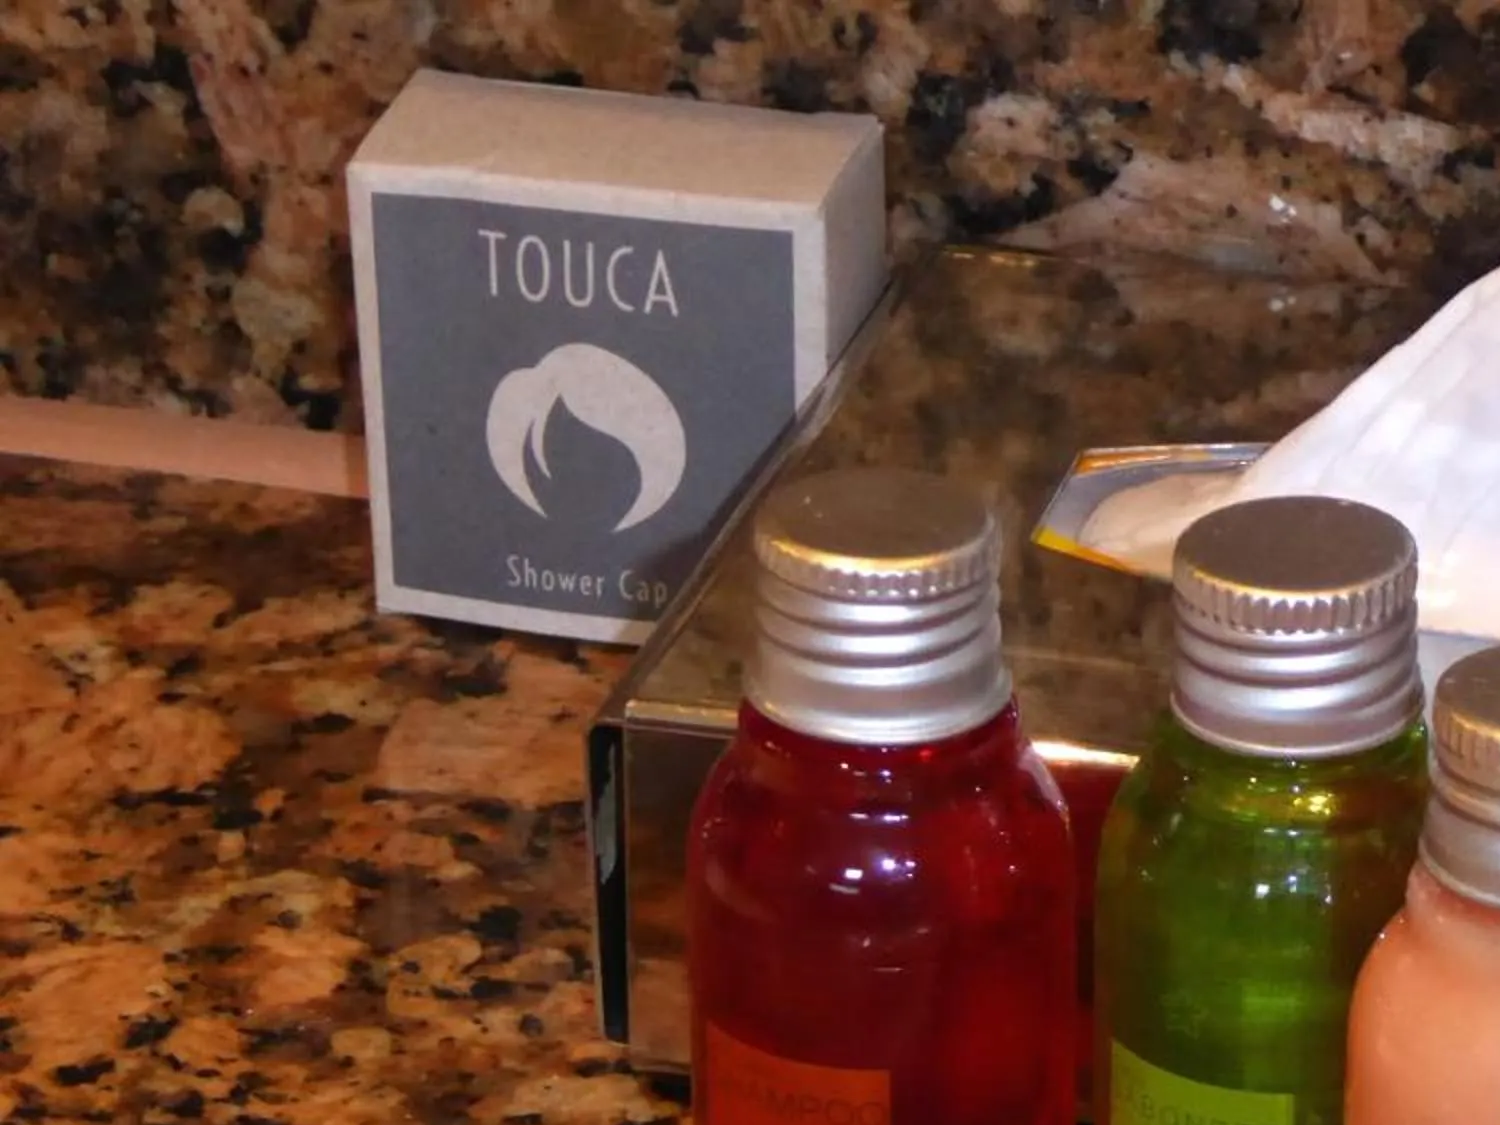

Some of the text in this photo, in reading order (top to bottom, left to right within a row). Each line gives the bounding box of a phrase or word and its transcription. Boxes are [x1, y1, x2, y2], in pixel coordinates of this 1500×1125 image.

[477, 228, 680, 319] TOUCA
[505, 554, 669, 609] Shower Cap
